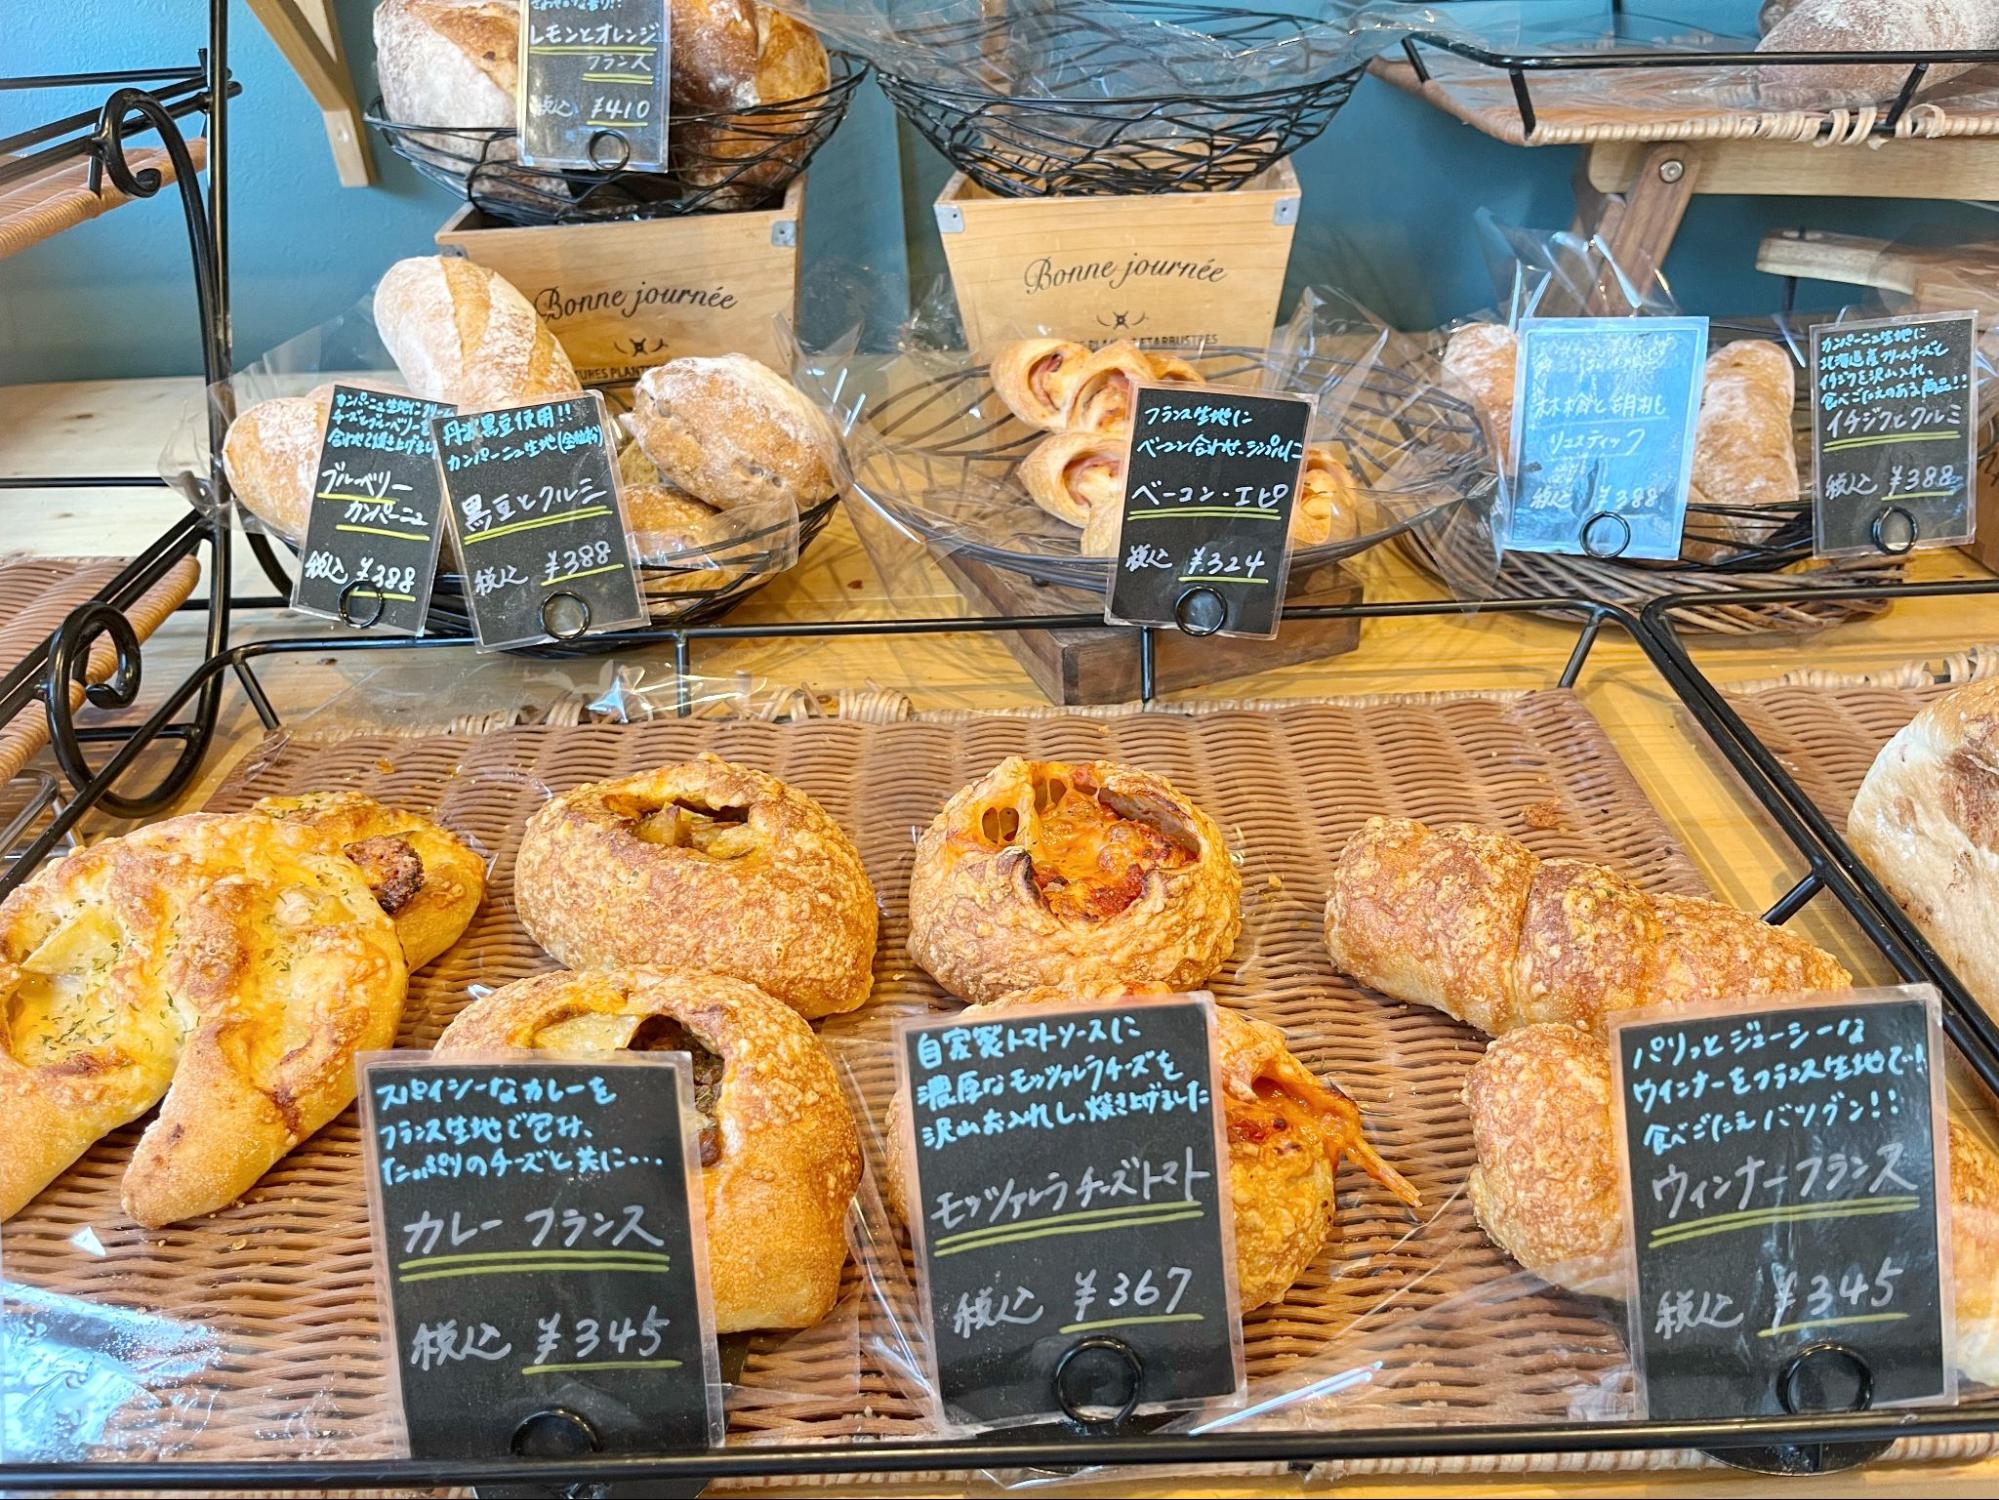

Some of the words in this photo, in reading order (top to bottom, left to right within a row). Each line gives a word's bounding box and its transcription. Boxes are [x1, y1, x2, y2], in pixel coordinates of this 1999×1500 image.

[530, 22, 660, 45] レモンとオレンジ
[588, 55, 651, 71] フランス
[591, 96, 650, 119] ¥410
[1024, 256, 1116, 294] Bonne
[1110, 252, 1230, 290] journée
[534, 285, 627, 323] Bonne
[621, 281, 738, 317] journée
[1144, 405, 1253, 428] フランス生地に
[1827, 404, 1961, 438] イチジクとクルミ
[320, 462, 413, 499] ブルーベリー
[1131, 480, 1289, 508] ベーコン・エピ
[1530, 486, 1573, 509] 税込
[1598, 485, 1658, 507] ¥388
[1825, 473, 1878, 499] 税込
[1889, 465, 1955, 496] ¥388
[344, 500, 429, 527] カンパーニュ
[461, 478, 607, 533] 黒豆とクルミ
[305, 550, 348, 585] 税込
[356, 556, 417, 594] ¥388
[473, 568, 529, 597] 税込
[544, 540, 612, 580] ¥388
[1125, 544, 1173, 572] 税込
[1188, 546, 1265, 578] ¥324
[917, 1015, 1141, 1070] 自家製トマトソースに
[1632, 1018, 1866, 1070] パリッとジューシーな
[376, 1075, 617, 1111] スパイシーなカレーを
[917, 1050, 1184, 1112] 濃厚なモッツァレラチーズを
[380, 1112, 593, 1150] フランス生地で包み、
[953, 1285, 1043, 1339] 税込
[1074, 1267, 1192, 1322] ¥367
[1654, 1289, 1743, 1339] 税込
[1772, 1258, 1904, 1332] ¥345
[410, 1319, 511, 1371] 税込
[534, 1305, 669, 1365] ¥345
